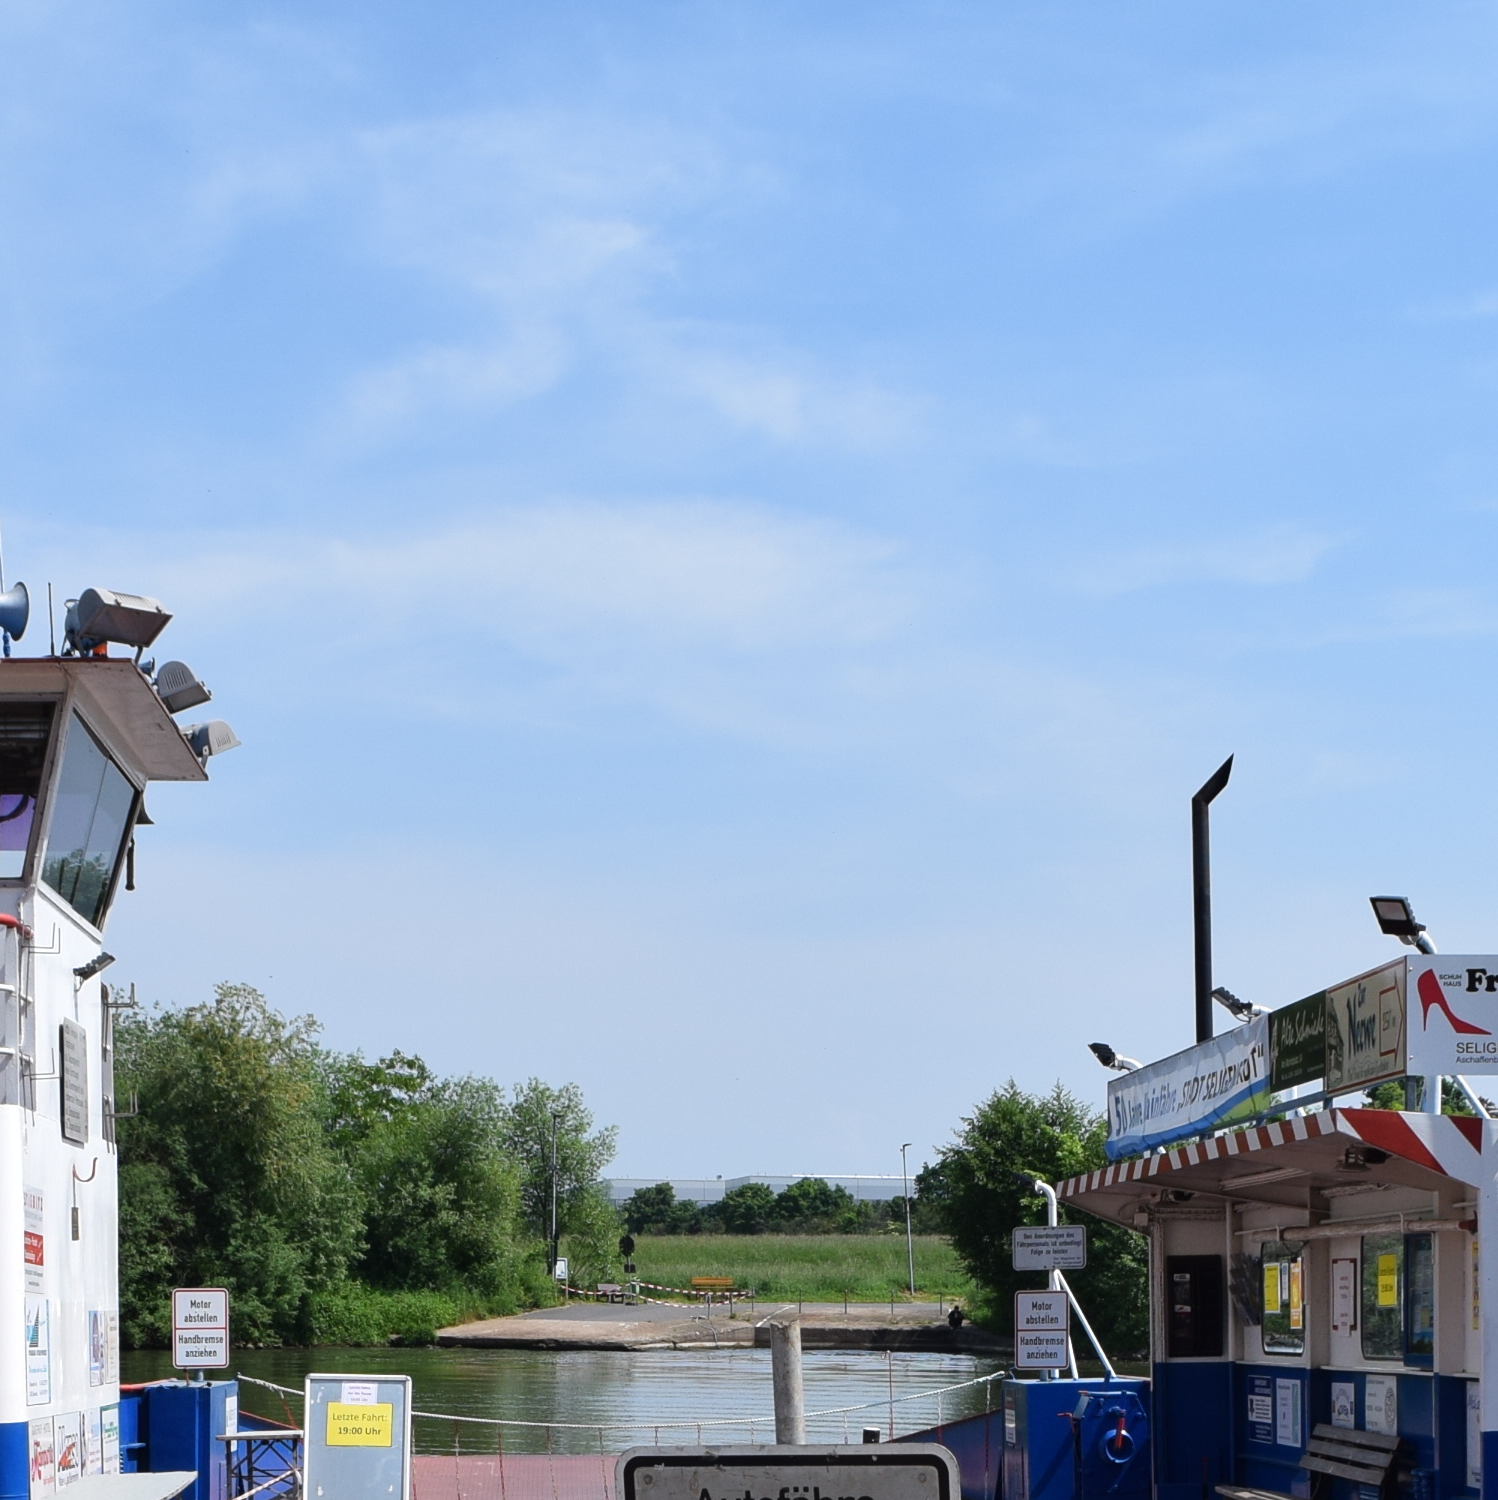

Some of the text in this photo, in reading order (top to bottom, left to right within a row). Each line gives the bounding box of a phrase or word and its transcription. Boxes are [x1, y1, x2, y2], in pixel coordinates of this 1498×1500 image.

[1114, 1092, 1128, 1137] 50
[190, 1300, 212, 1309] Motor
[1031, 1301, 1052, 1311] Motor
[184, 1313, 218, 1323] abstellen
[1025, 1314, 1059, 1324] abstellen
[178, 1334, 223, 1344] Handbremse
[1020, 1336, 1064, 1346] Handbremse
[185, 1348, 217, 1357] anziehen
[1026, 1349, 1058, 1359] anziehen
[332, 1413, 388, 1422] Letzte Fahrt:
[338, 1427, 381, 1435] 19:00 Uhr
